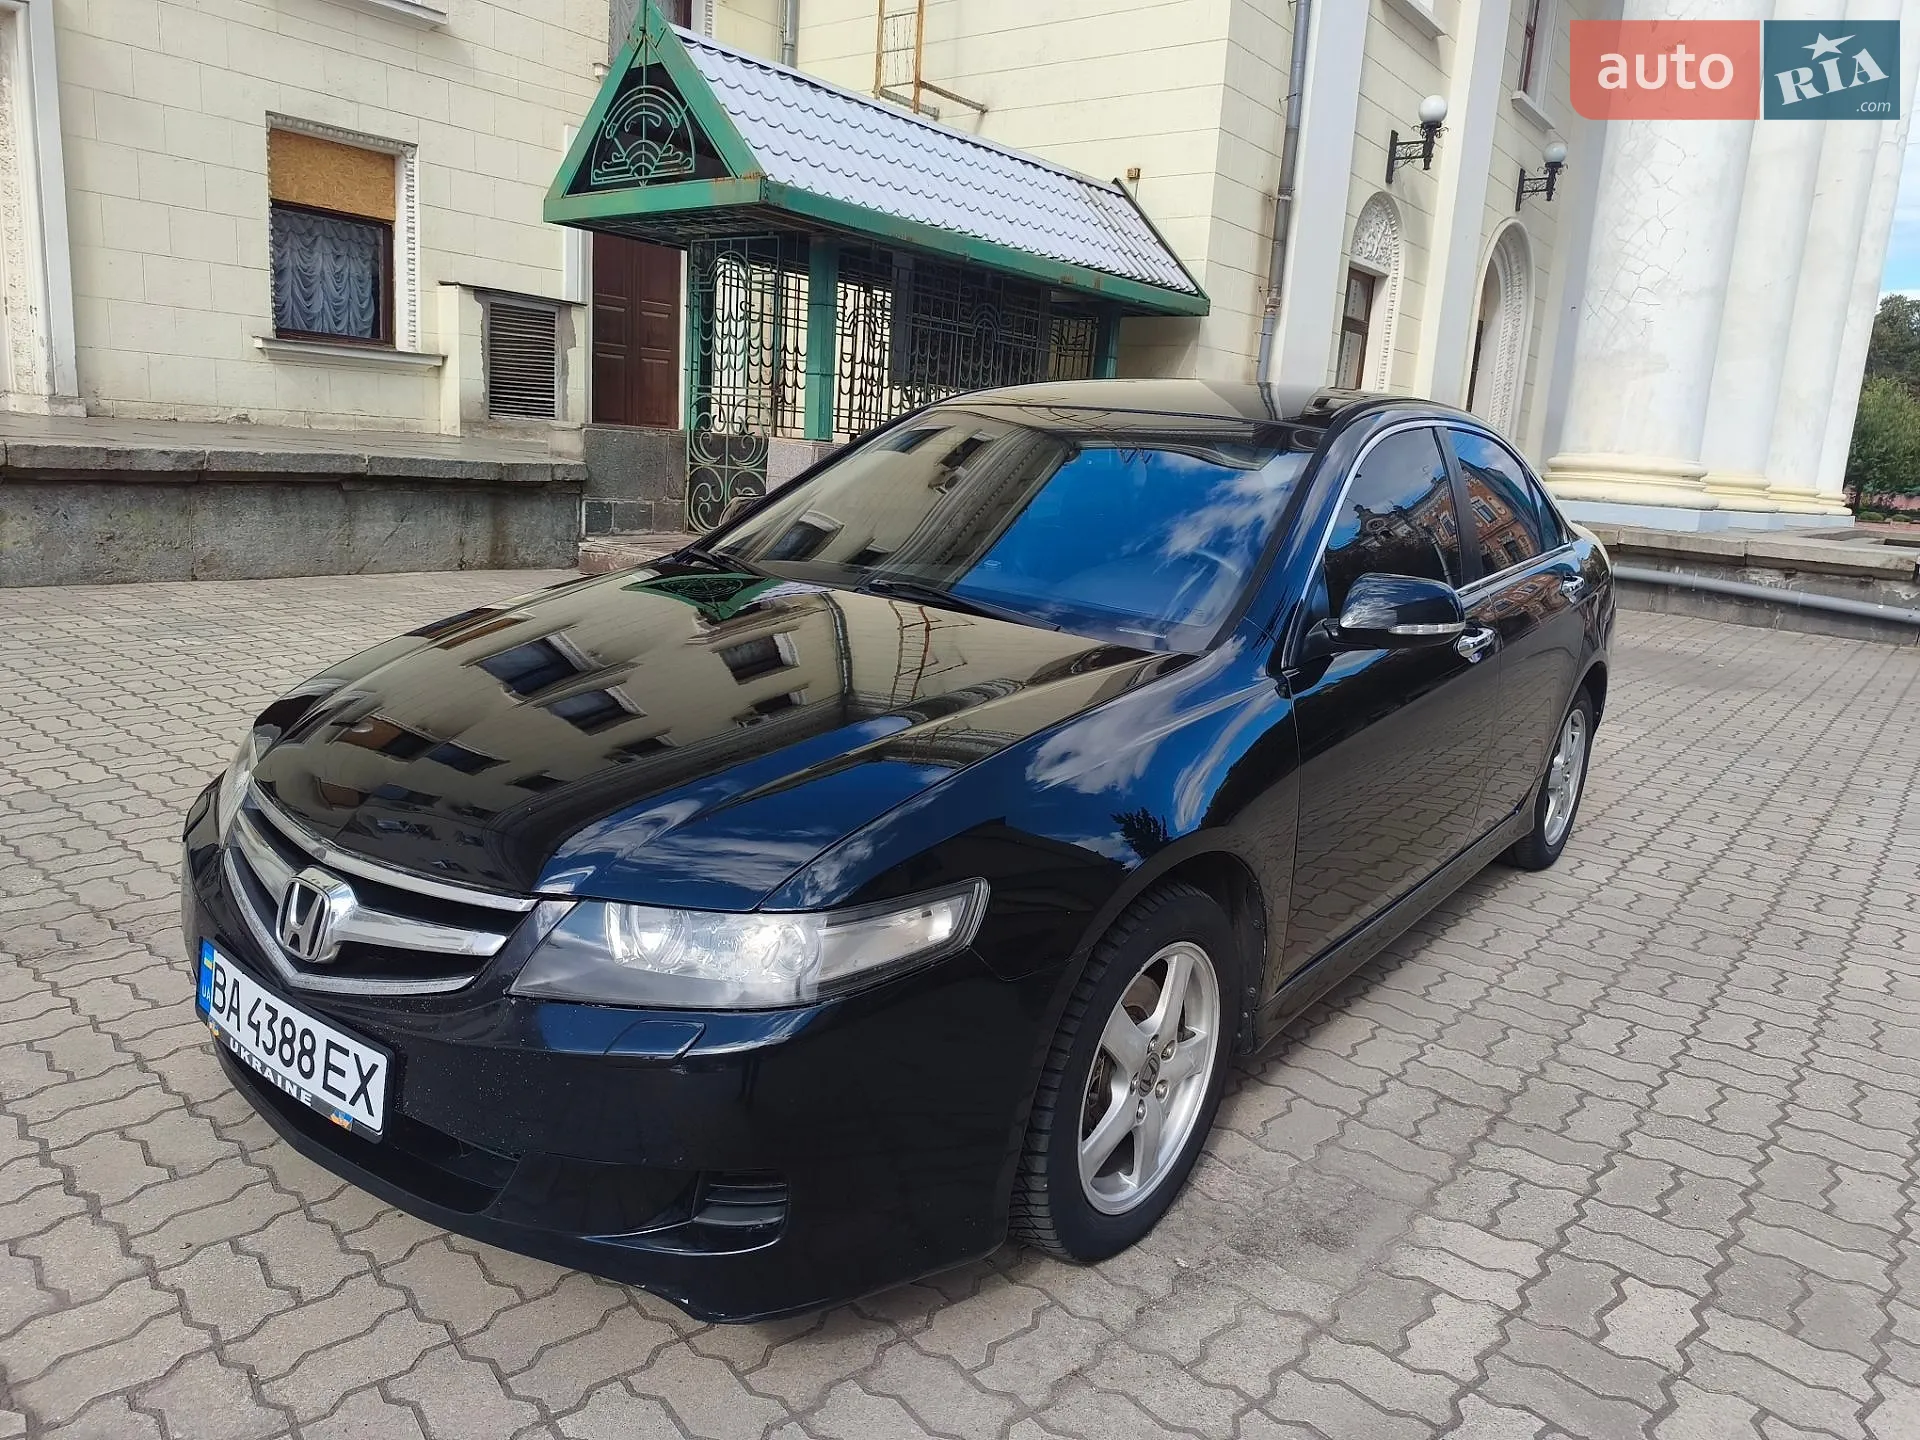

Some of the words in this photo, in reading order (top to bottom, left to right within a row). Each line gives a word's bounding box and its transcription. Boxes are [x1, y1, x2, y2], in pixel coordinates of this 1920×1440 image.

[201, 984, 211, 1003] UA
[212, 961, 241, 1032] BA
[247, 997, 316, 1080] 4388
[322, 1038, 379, 1118] EX
[229, 1037, 313, 1107] UKRAINE
